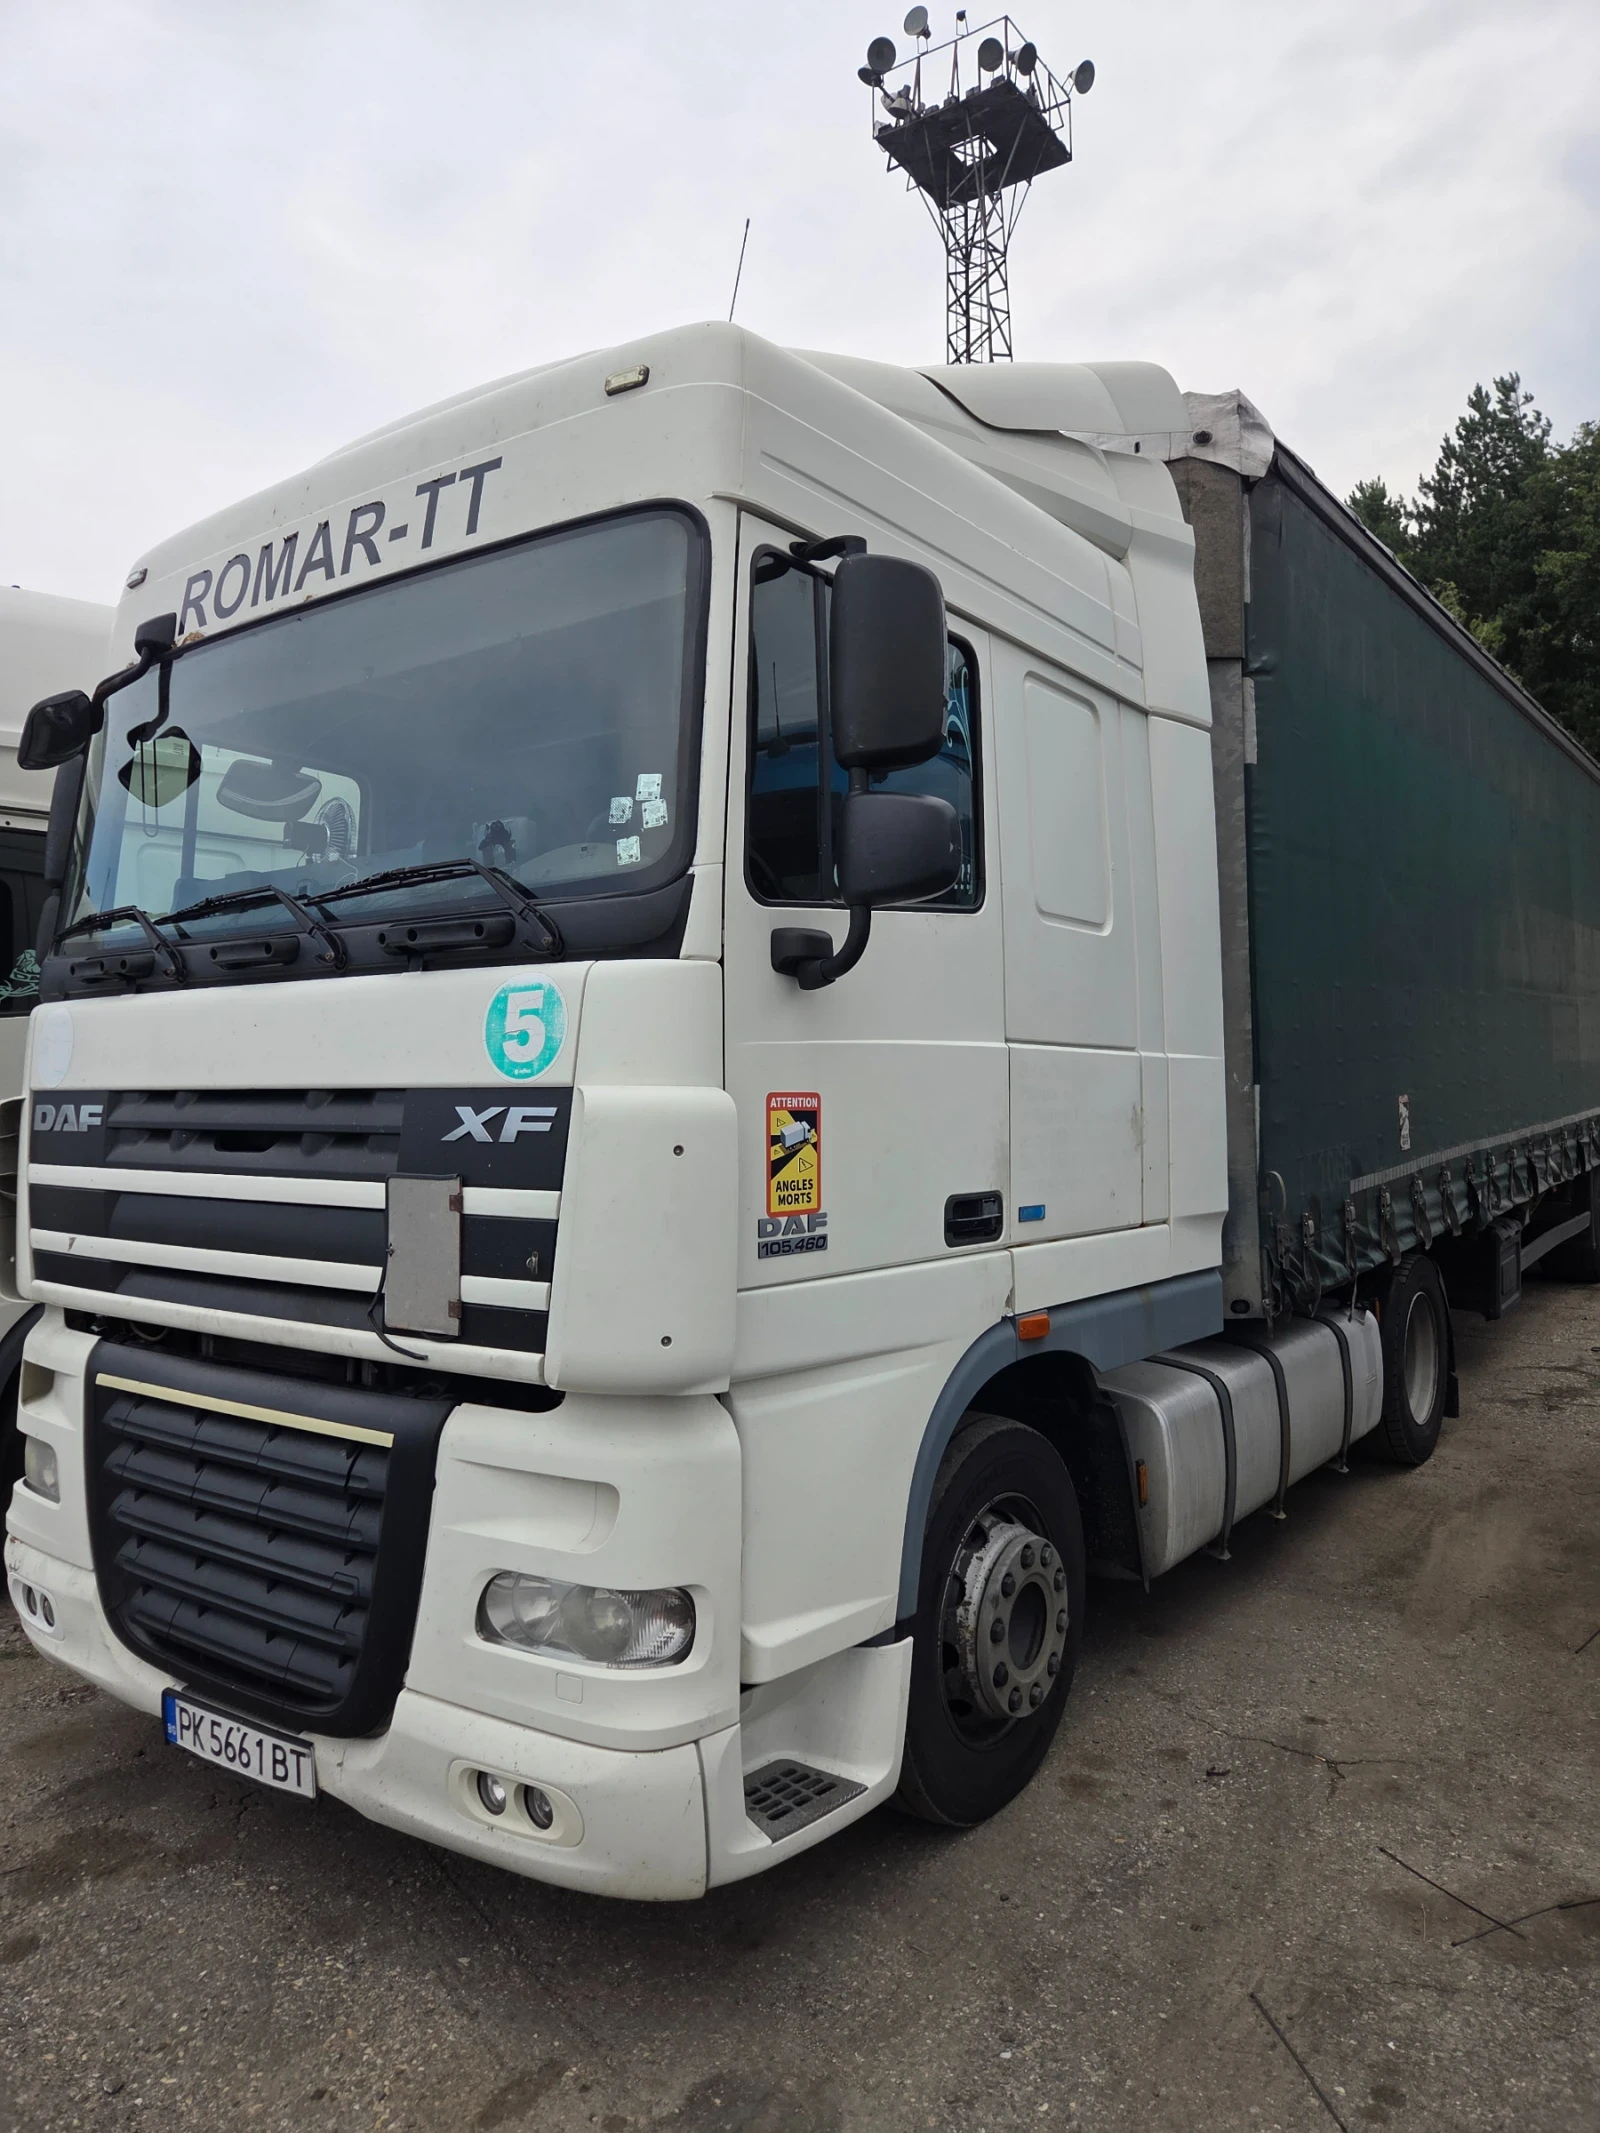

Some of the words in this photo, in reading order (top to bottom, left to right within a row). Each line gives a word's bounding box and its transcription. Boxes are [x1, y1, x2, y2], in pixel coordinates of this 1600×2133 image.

[178, 456, 503, 636] ROMAR-TT
[502, 989, 545, 1063] 5
[770, 1097, 818, 1108] ATTENTION
[33, 1104, 104, 1132] DAF
[440, 1106, 558, 1142] XF
[775, 1178, 814, 1193] ANGLES
[778, 1192, 812, 1206] MORTS
[757, 1212, 828, 1238] DAF
[760, 1235, 827, 1256] 105.460
